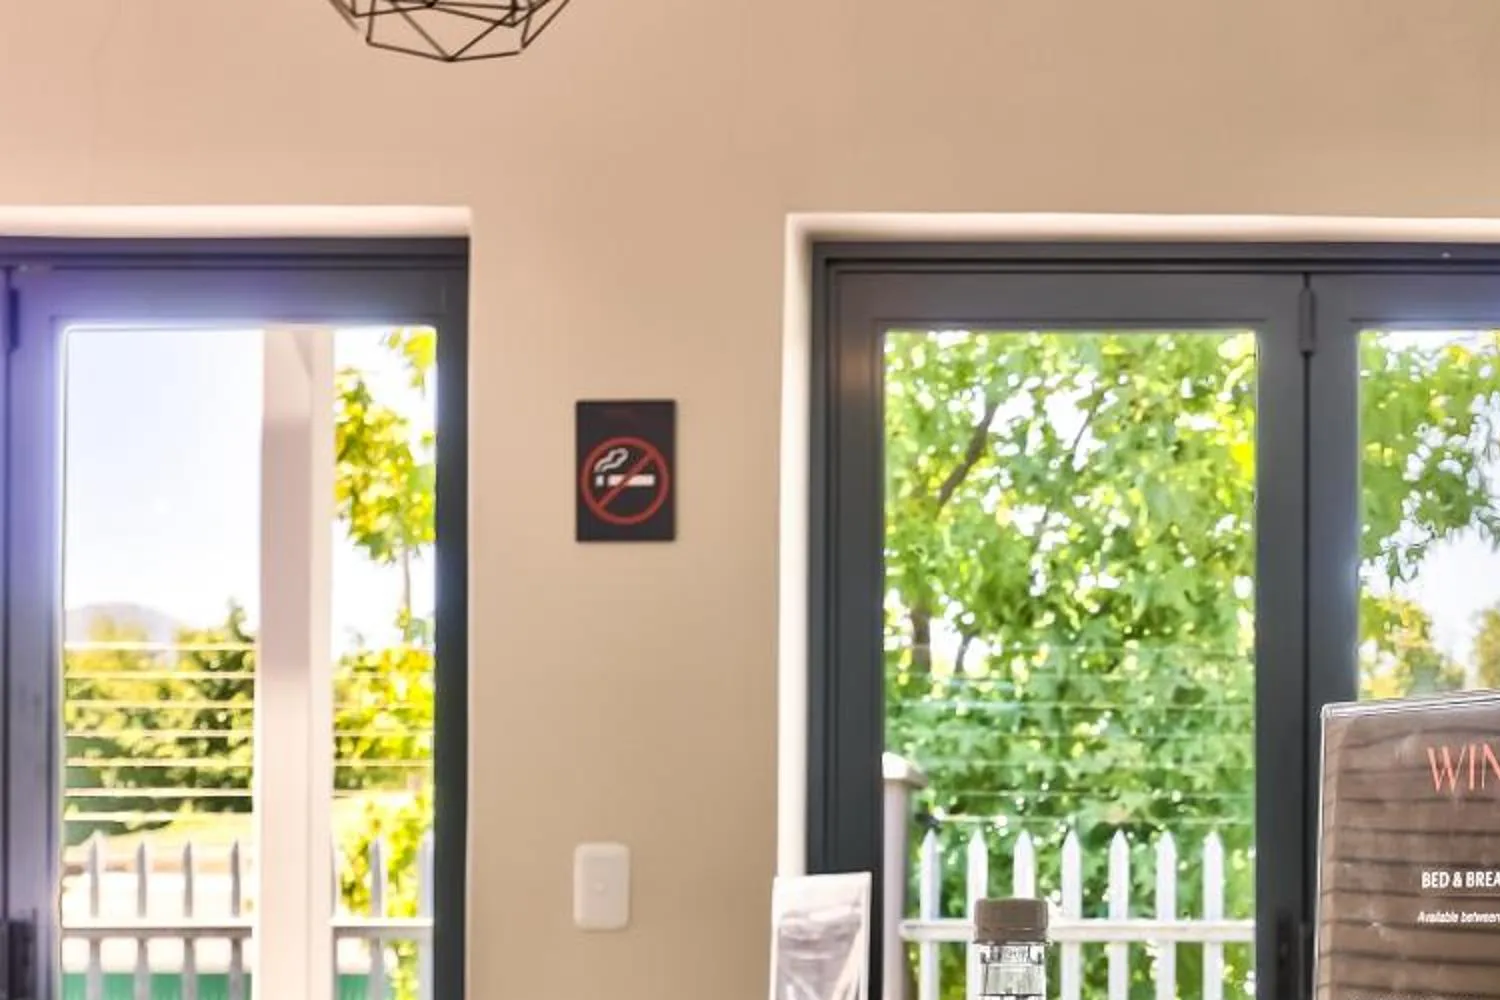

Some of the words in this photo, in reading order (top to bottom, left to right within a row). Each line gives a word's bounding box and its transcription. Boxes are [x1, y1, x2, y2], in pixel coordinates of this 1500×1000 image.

[1421, 871, 1449, 888] BED
[1452, 872, 1462, 888] &
[1417, 911, 1458, 923] Available
[1461, 911, 1500, 923] between
